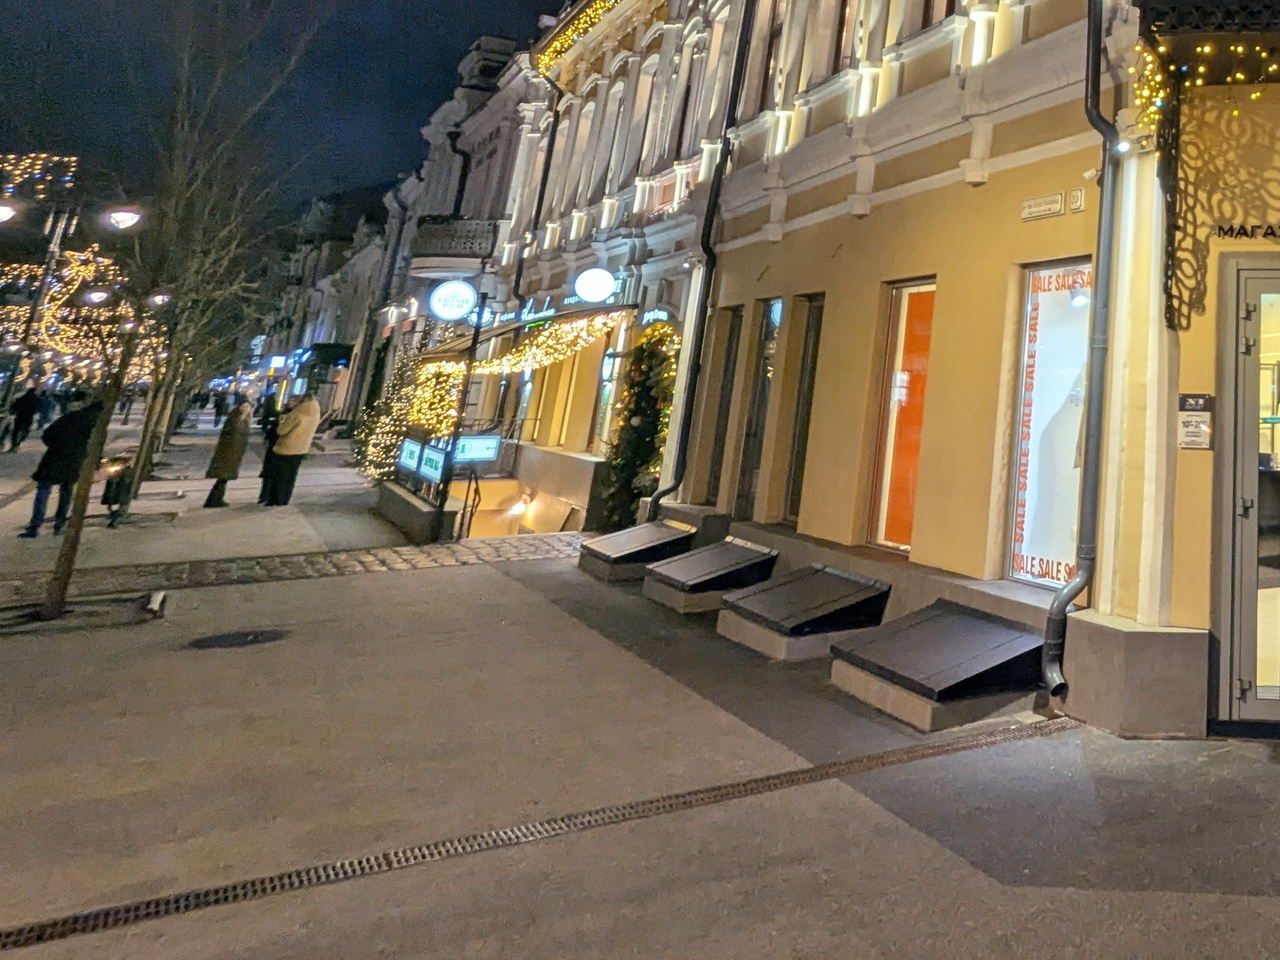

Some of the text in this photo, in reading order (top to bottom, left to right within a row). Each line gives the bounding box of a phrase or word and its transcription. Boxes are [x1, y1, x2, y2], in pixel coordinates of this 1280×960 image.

[1055, 272, 1078, 291] SALE
[1015, 302, 1039, 543] SALE SALE SALE SALE SALE
[1014, 553, 1035, 576] SALE
[1038, 558, 1061, 582] SALE
